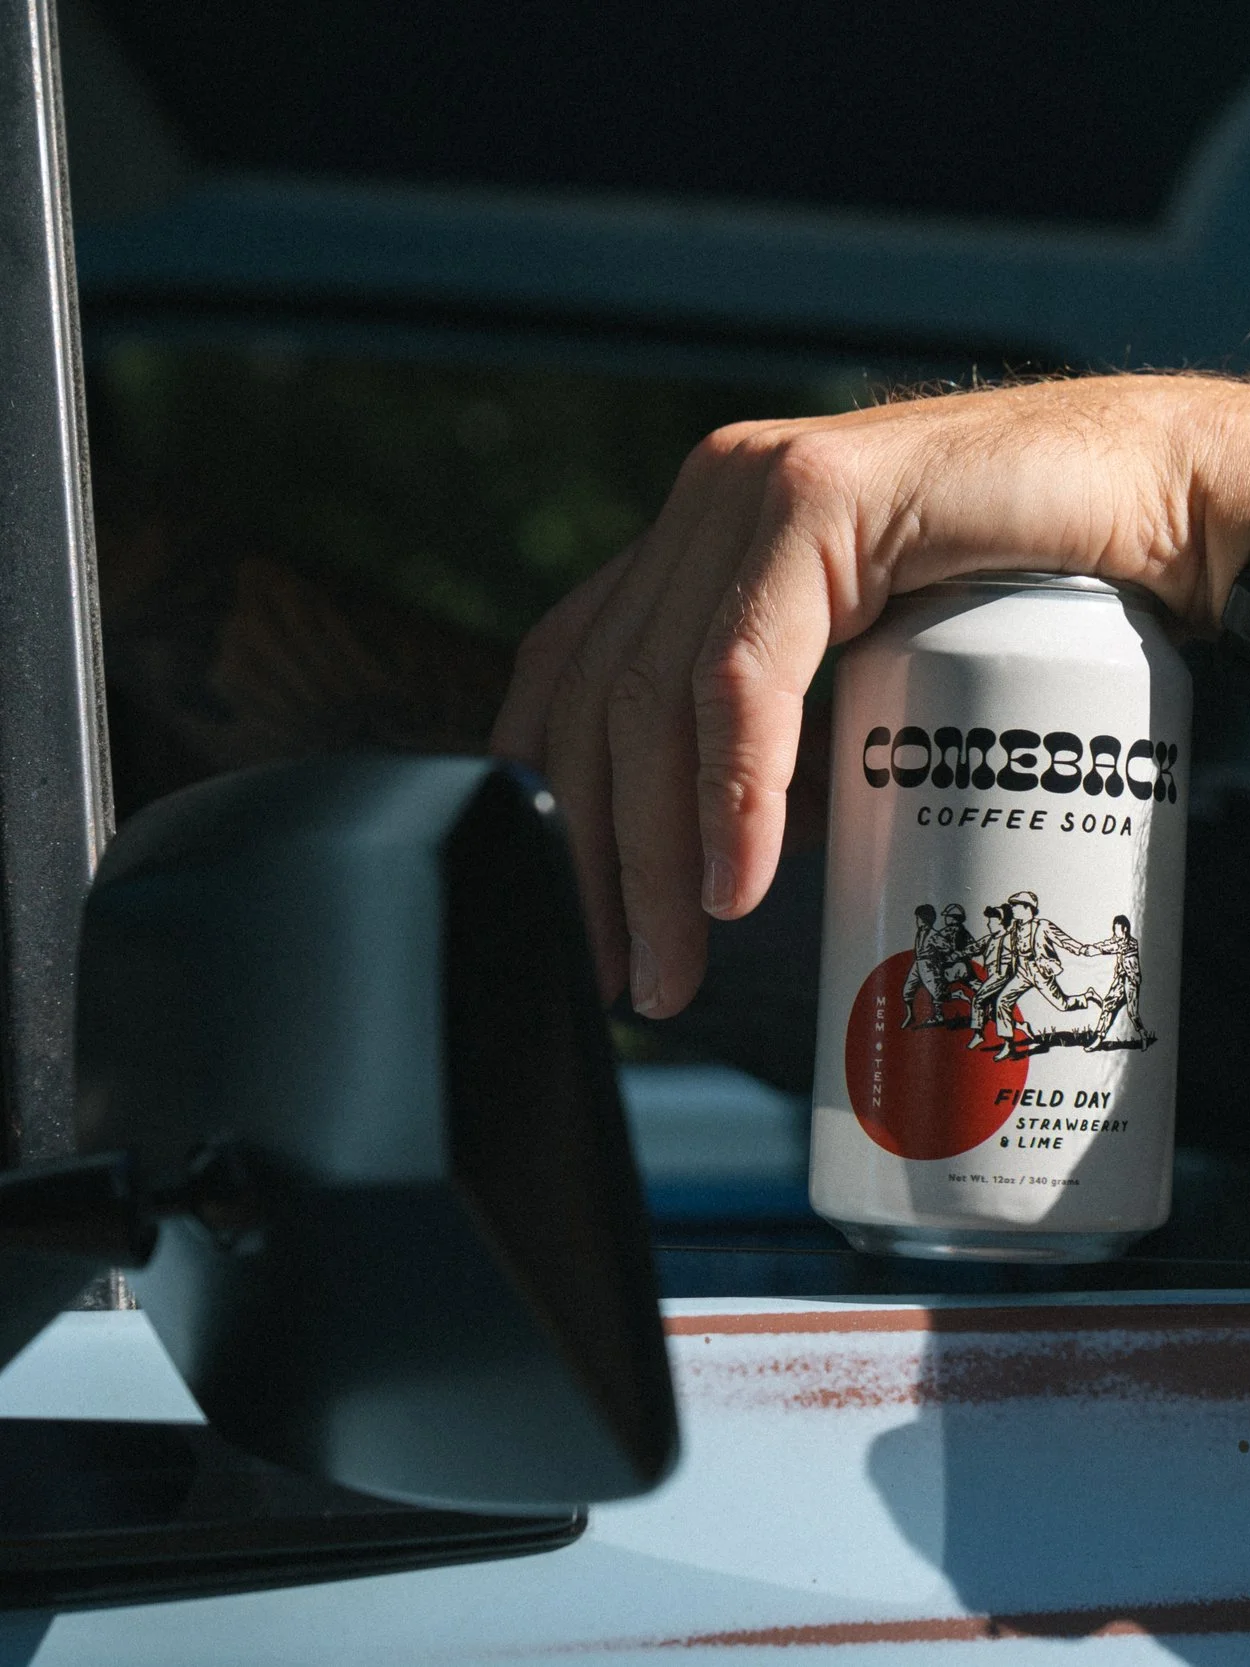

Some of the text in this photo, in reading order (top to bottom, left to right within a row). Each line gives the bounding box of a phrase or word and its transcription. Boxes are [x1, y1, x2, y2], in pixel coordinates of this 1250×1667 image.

[863, 726, 1178, 804] COMEBACK
[917, 806, 1132, 837] COFFEE SODA
[872, 996, 887, 1108] MEM TENN
[994, 1089, 1112, 1109] FIELD DAY
[1015, 1117, 1129, 1132] STRAWBERRY
[1017, 1136, 1064, 1149] LIME
[948, 1174, 967, 1182] Net
[993, 1174, 1015, 1184] 12oz
[1028, 1175, 1048, 1185] 340
[1051, 1177, 1080, 1187] grams
